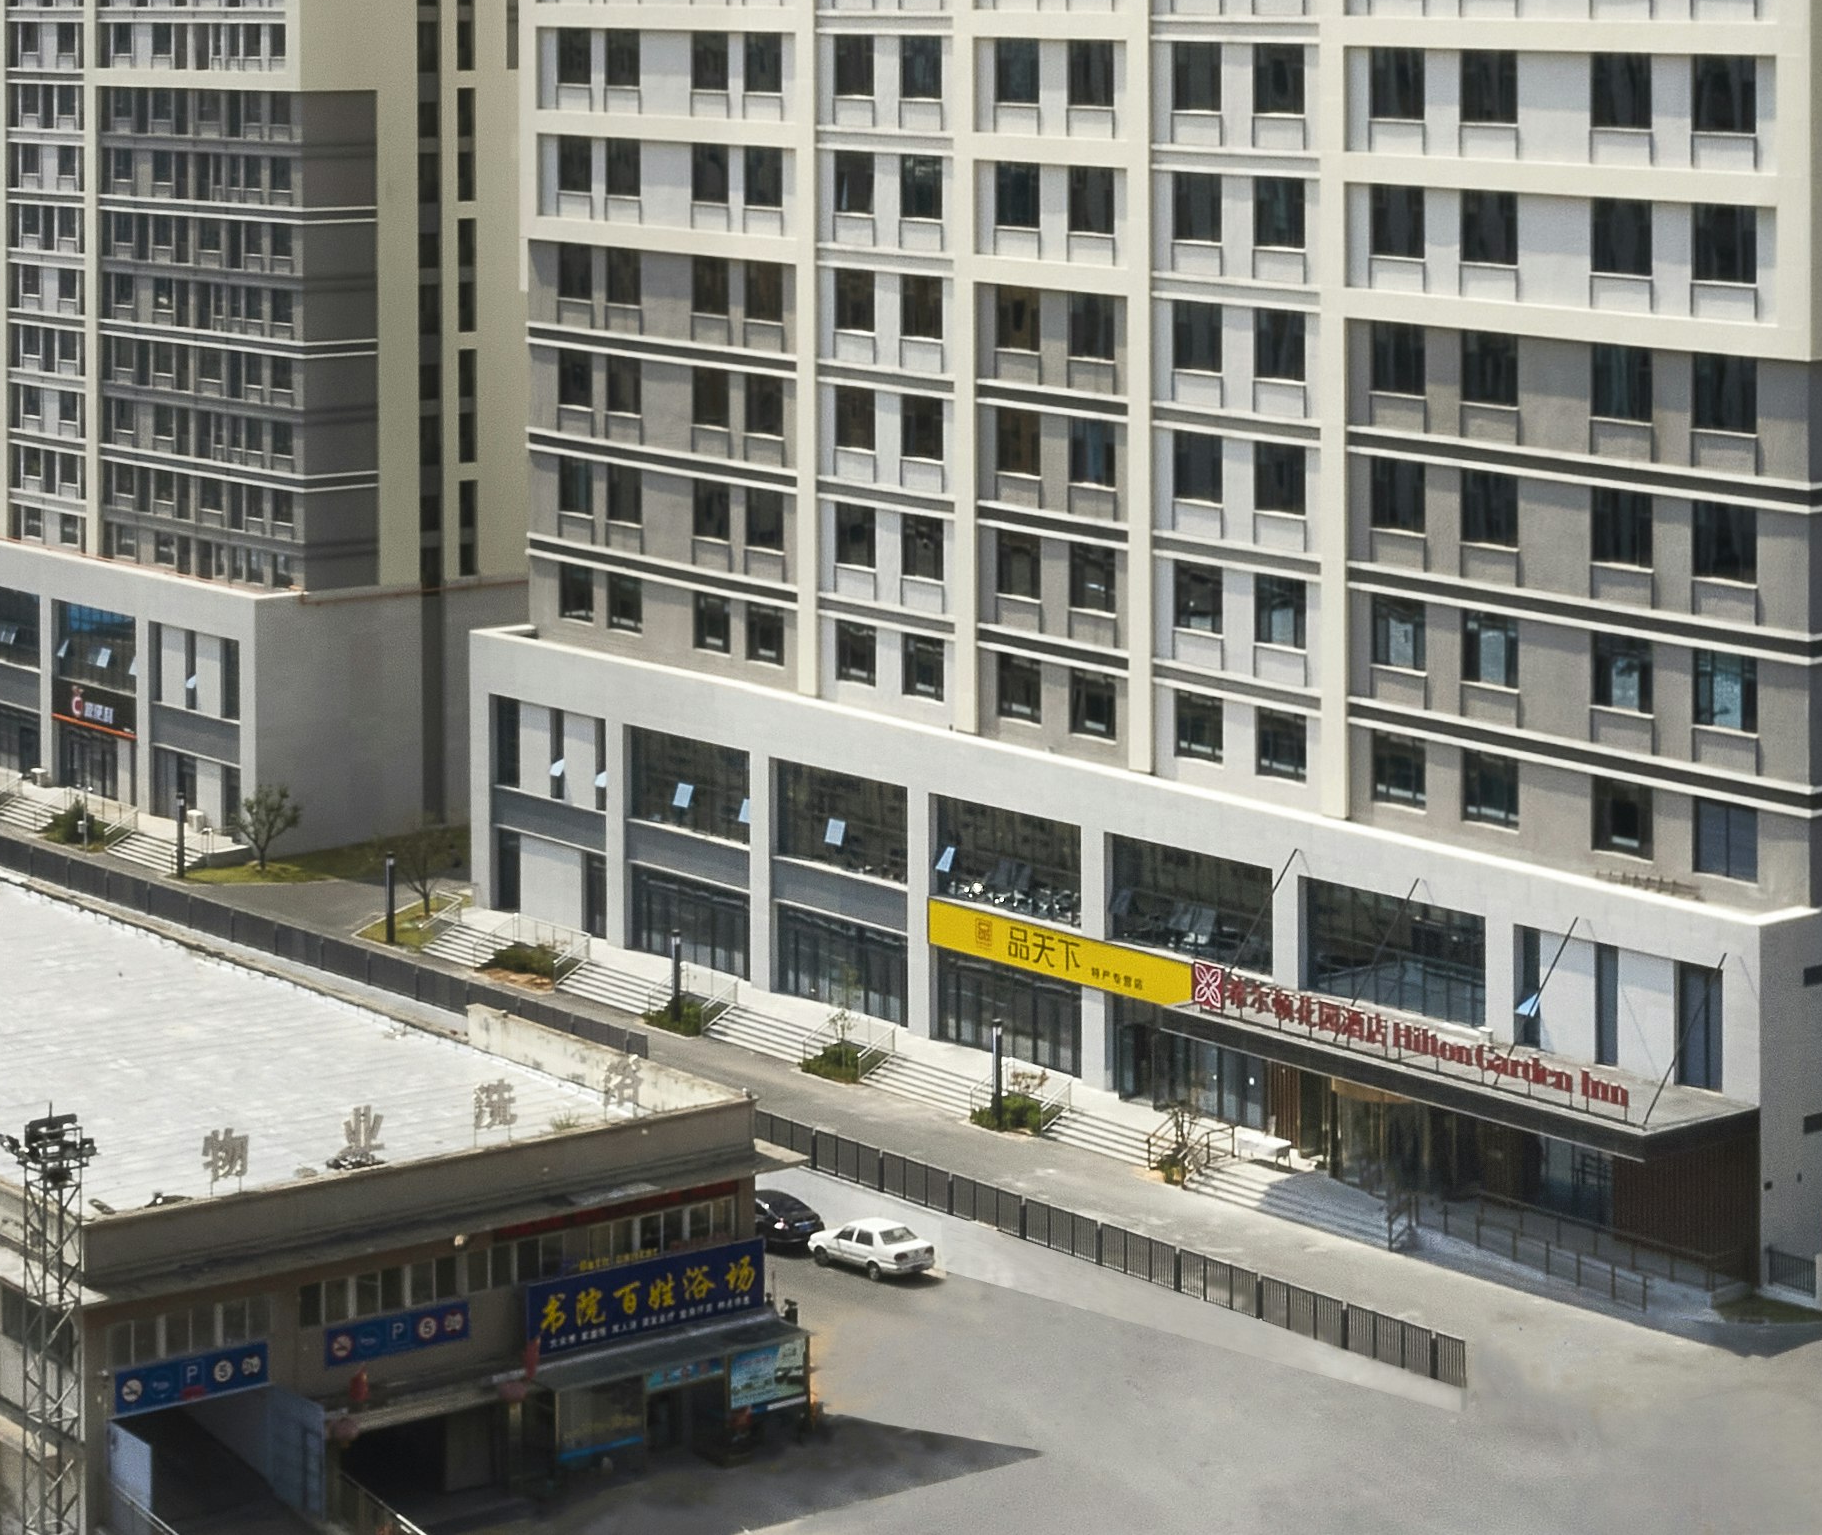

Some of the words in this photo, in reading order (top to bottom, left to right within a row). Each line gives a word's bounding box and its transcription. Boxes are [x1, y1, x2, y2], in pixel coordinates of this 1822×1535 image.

[1007, 925, 1081, 971] 品天下
[1224, 976, 1388, 1047] 希尔顿花园酒店
[1392, 1021, 1473, 1067] Hilton
[1475, 1043, 1574, 1093] Garden
[1580, 1068, 1629, 1108] Inn
[540, 1254, 756, 1335] 书院百姓浴场
[391, 1322, 404, 1340] P
[186, 1365, 198, 1384] P
